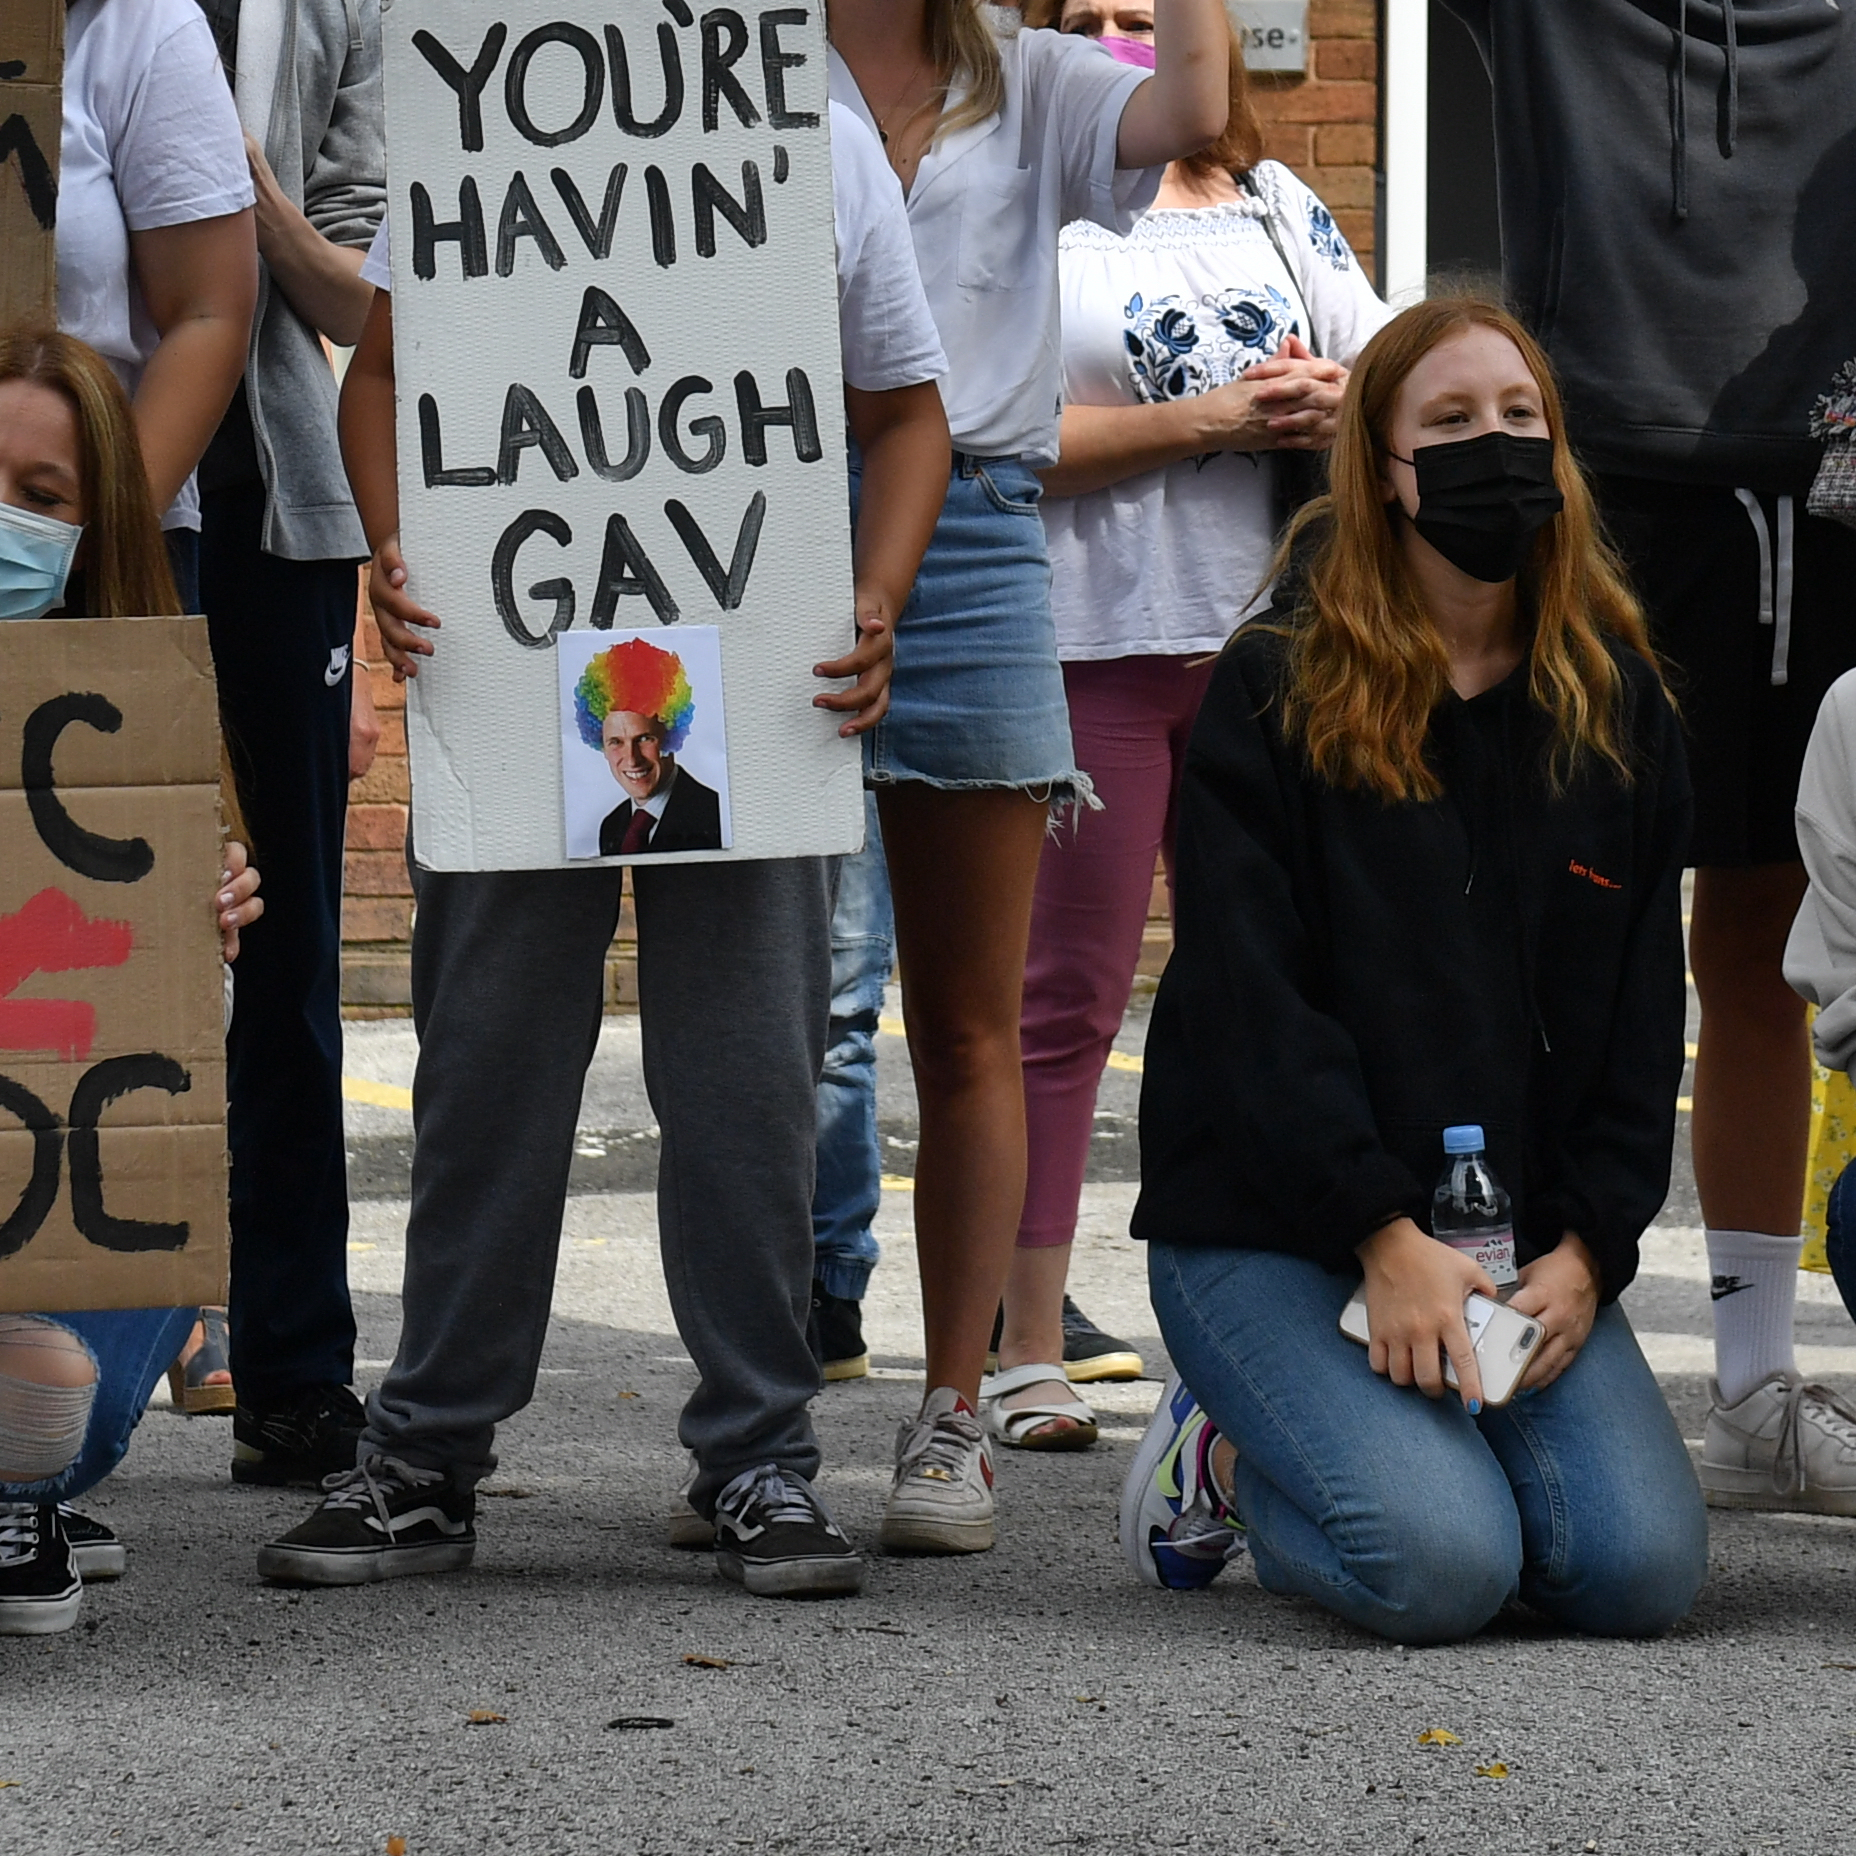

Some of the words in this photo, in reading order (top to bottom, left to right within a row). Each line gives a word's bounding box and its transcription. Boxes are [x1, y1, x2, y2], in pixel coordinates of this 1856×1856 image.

[409, 144, 789, 282] HAVIN'
[568, 285, 651, 380] A
[417, 367, 823, 488] LAUGH
[490, 489, 767, 651] GAV
[1476, 1247, 1511, 1263] evian
